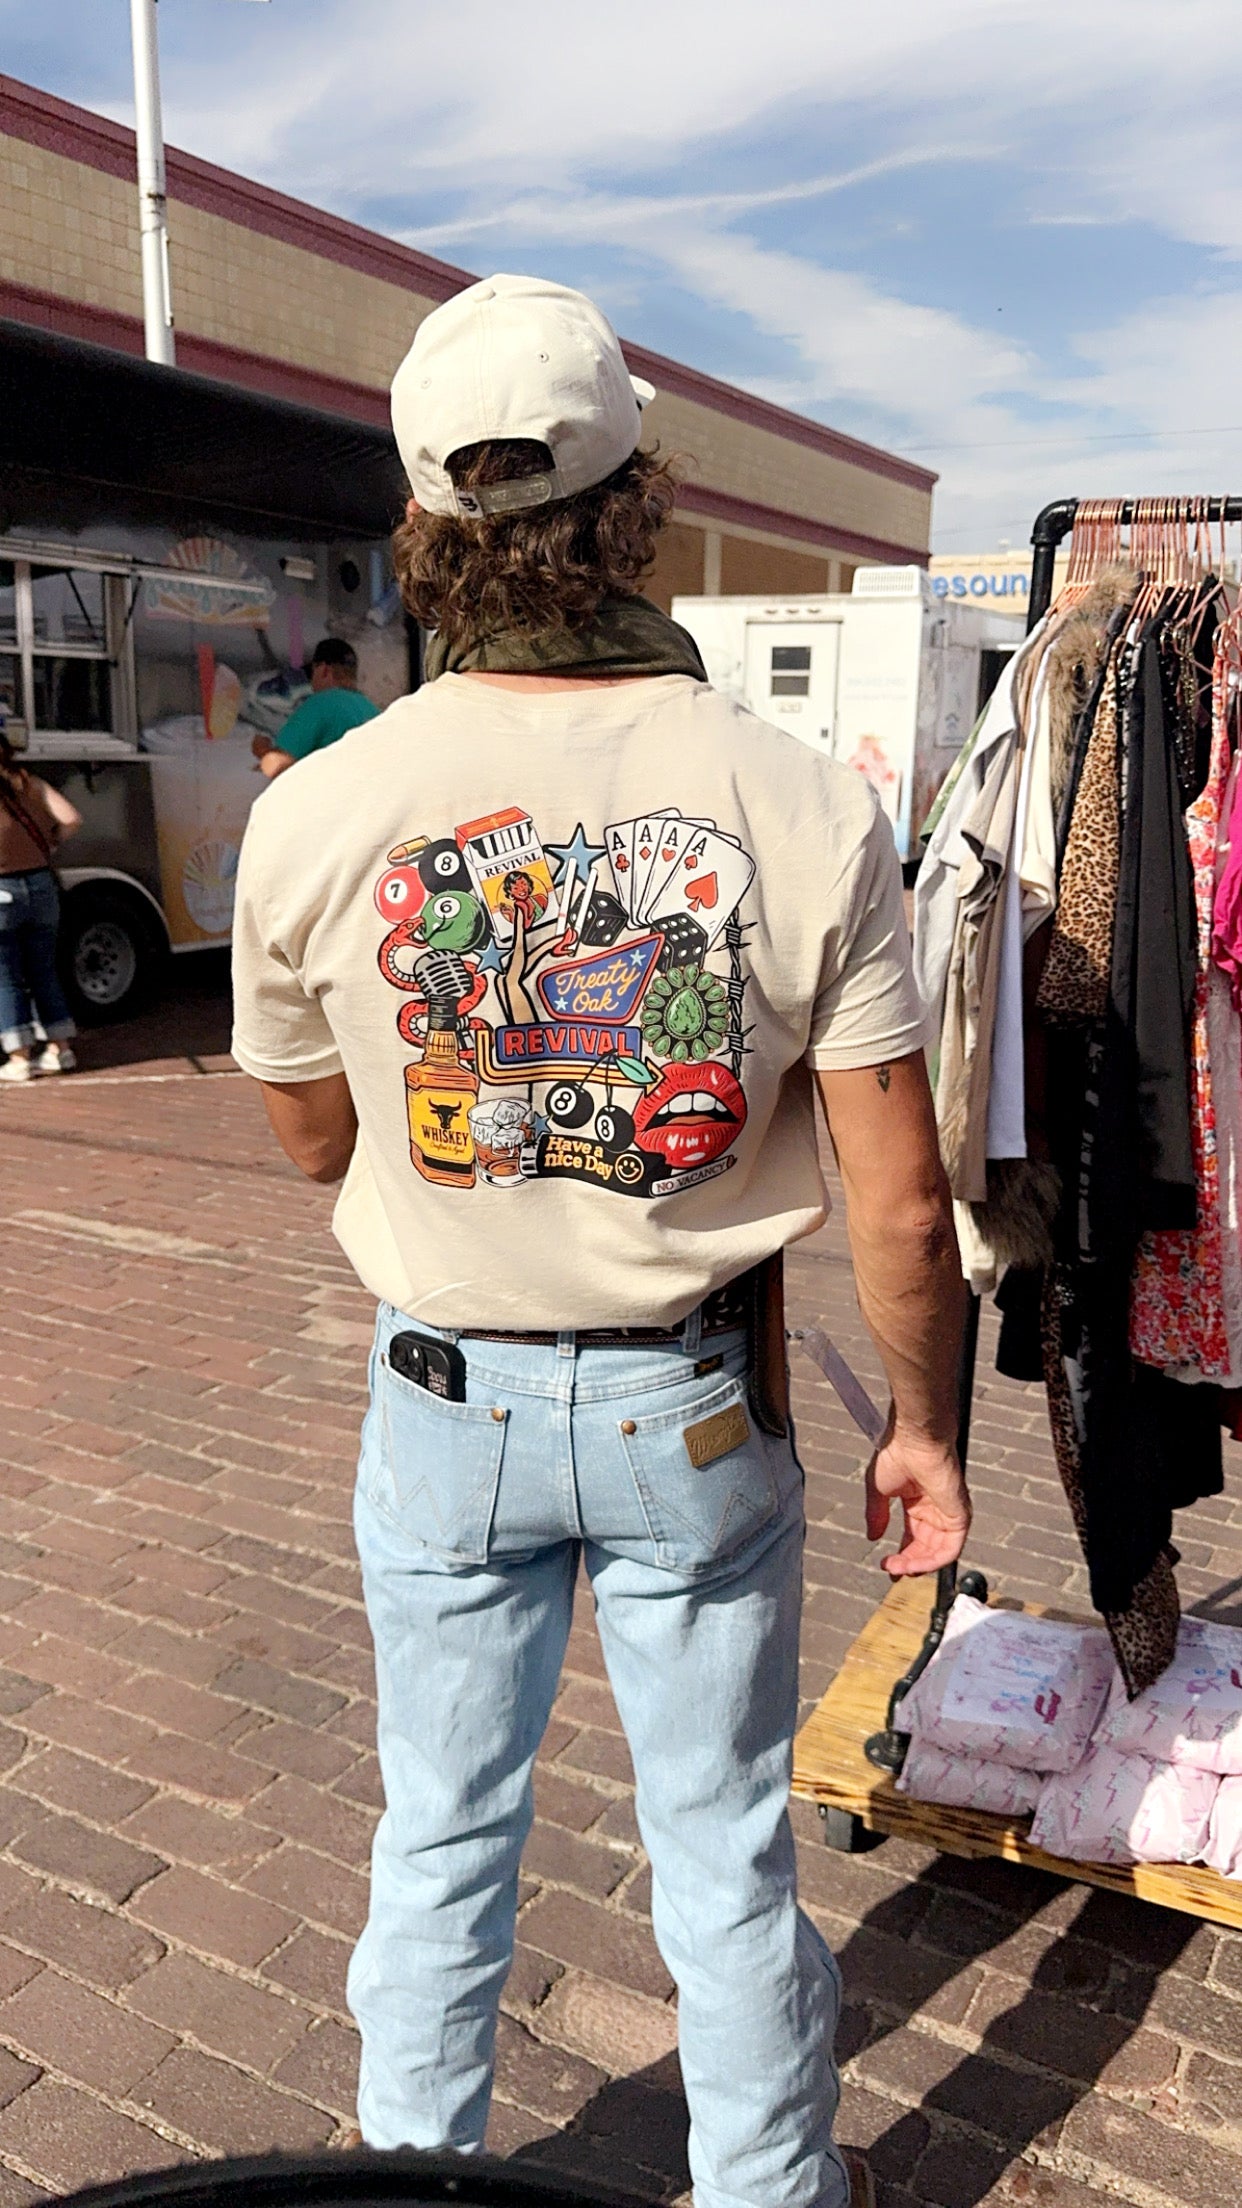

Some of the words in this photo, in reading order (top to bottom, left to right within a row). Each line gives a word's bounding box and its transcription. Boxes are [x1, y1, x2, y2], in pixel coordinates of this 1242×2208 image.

[931, 573, 1028, 598] esoun
[612, 831, 626, 851] A
[638, 824, 653, 842] A
[664, 827, 678, 846] A
[691, 837, 707, 856] A
[441, 856, 452, 872] 8
[485, 852, 541, 878] REVIVAL
[390, 883, 400, 899] 7
[440, 900, 452, 913] 6
[556, 959, 641, 996] Treaty
[572, 989, 619, 1013] Oak
[504, 1026, 634, 1057] REVIVAL
[554, 1091, 572, 1111] 8
[421, 1124, 469, 1146] WHISKEY
[601, 1119, 610, 1138] 8
[546, 1136, 592, 1154] Have
[593, 1145, 603, 1158] a
[544, 1150, 582, 1168] nice
[585, 1155, 613, 1180] Day
[656, 1180, 674, 1193] NO
[676, 1161, 726, 1187] VACANCY
